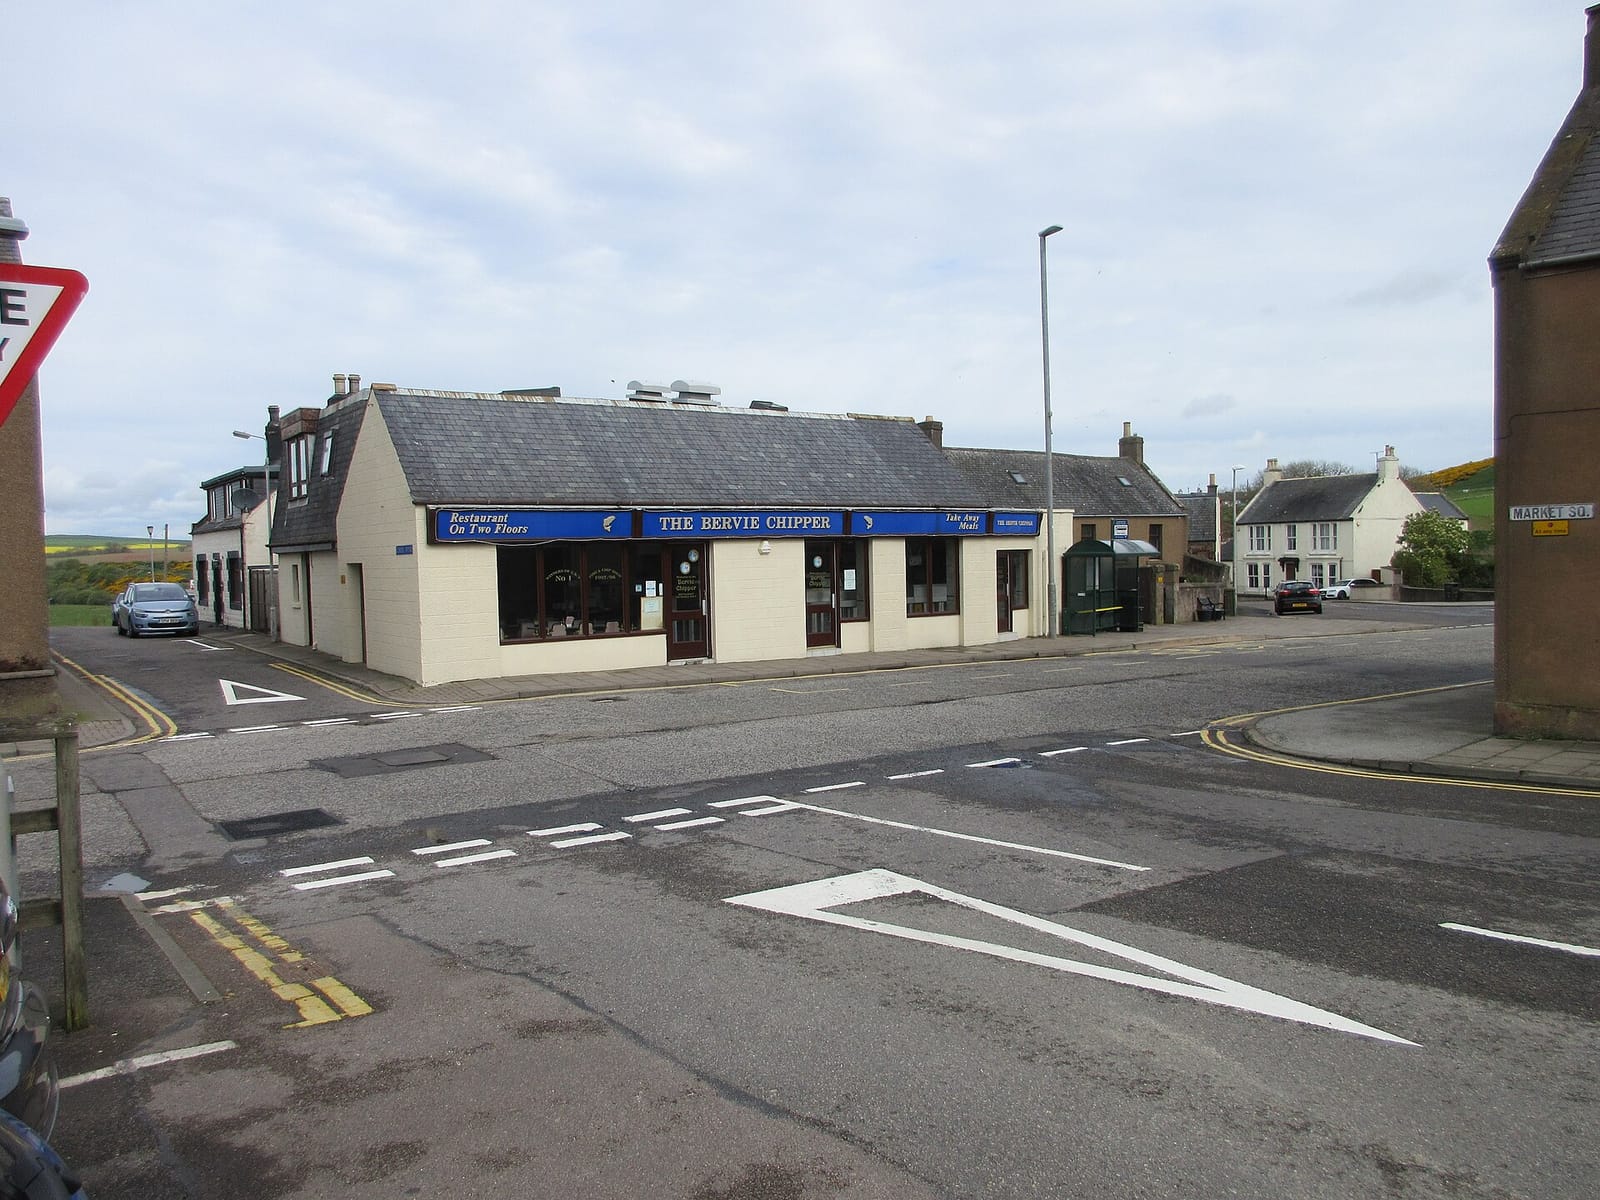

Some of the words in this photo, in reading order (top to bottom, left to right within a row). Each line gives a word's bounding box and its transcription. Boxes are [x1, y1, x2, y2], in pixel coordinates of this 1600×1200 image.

[450, 512, 509, 523] Restaurant
[946, 513, 962, 522] Take
[963, 513, 979, 523] Away
[1513, 507, 1564, 519] MARKET
[1568, 506, 1590, 517] SQ.
[449, 523, 465, 535] On
[469, 523, 491, 534] Two
[494, 523, 529, 534] Floors
[659, 516, 694, 531] THE
[700, 516, 760, 531] BERVIE
[766, 516, 831, 529] CHIPPER
[958, 521, 979, 530] Meals
